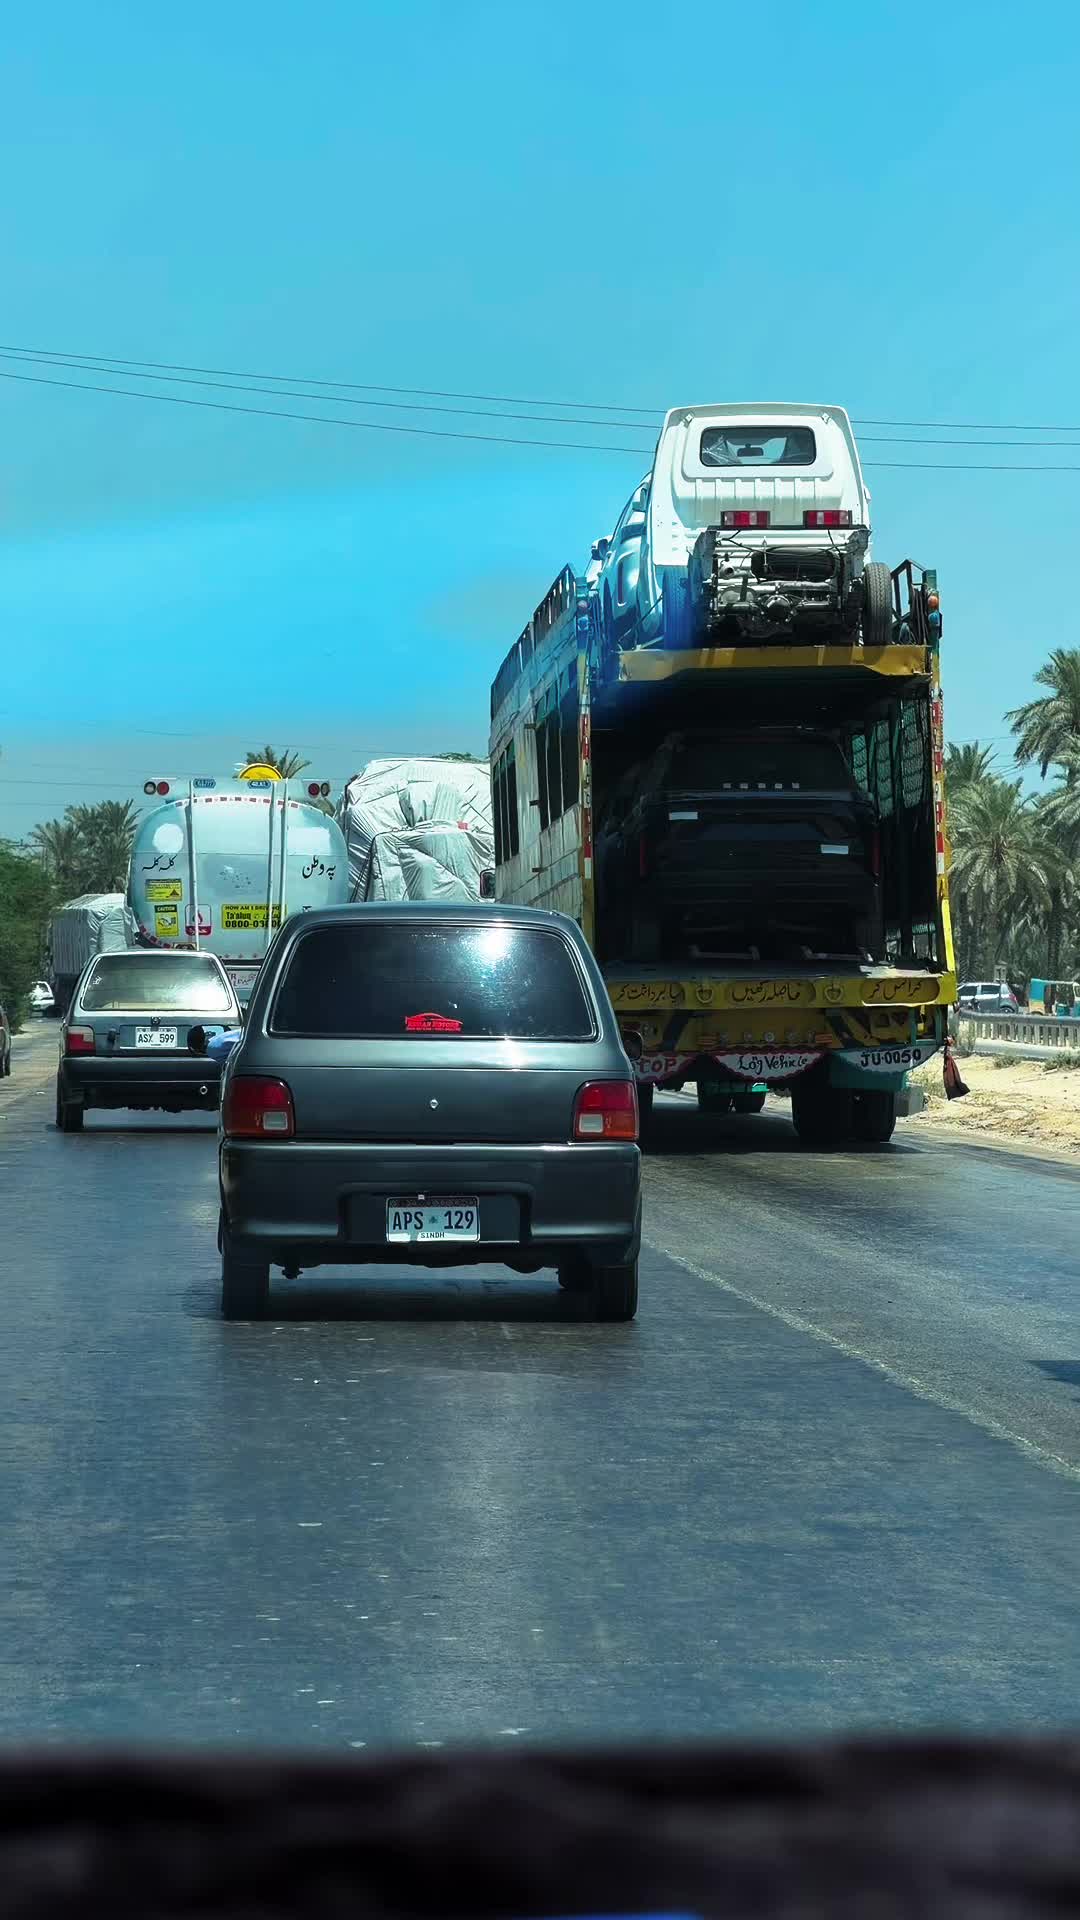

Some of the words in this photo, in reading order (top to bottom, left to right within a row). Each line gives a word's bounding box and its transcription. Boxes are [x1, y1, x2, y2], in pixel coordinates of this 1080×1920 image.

[138, 1033, 153, 1043] ASX
[160, 1033, 175, 1043] 599
[393, 1211, 424, 1230] APS
[444, 1210, 475, 1230] 129
